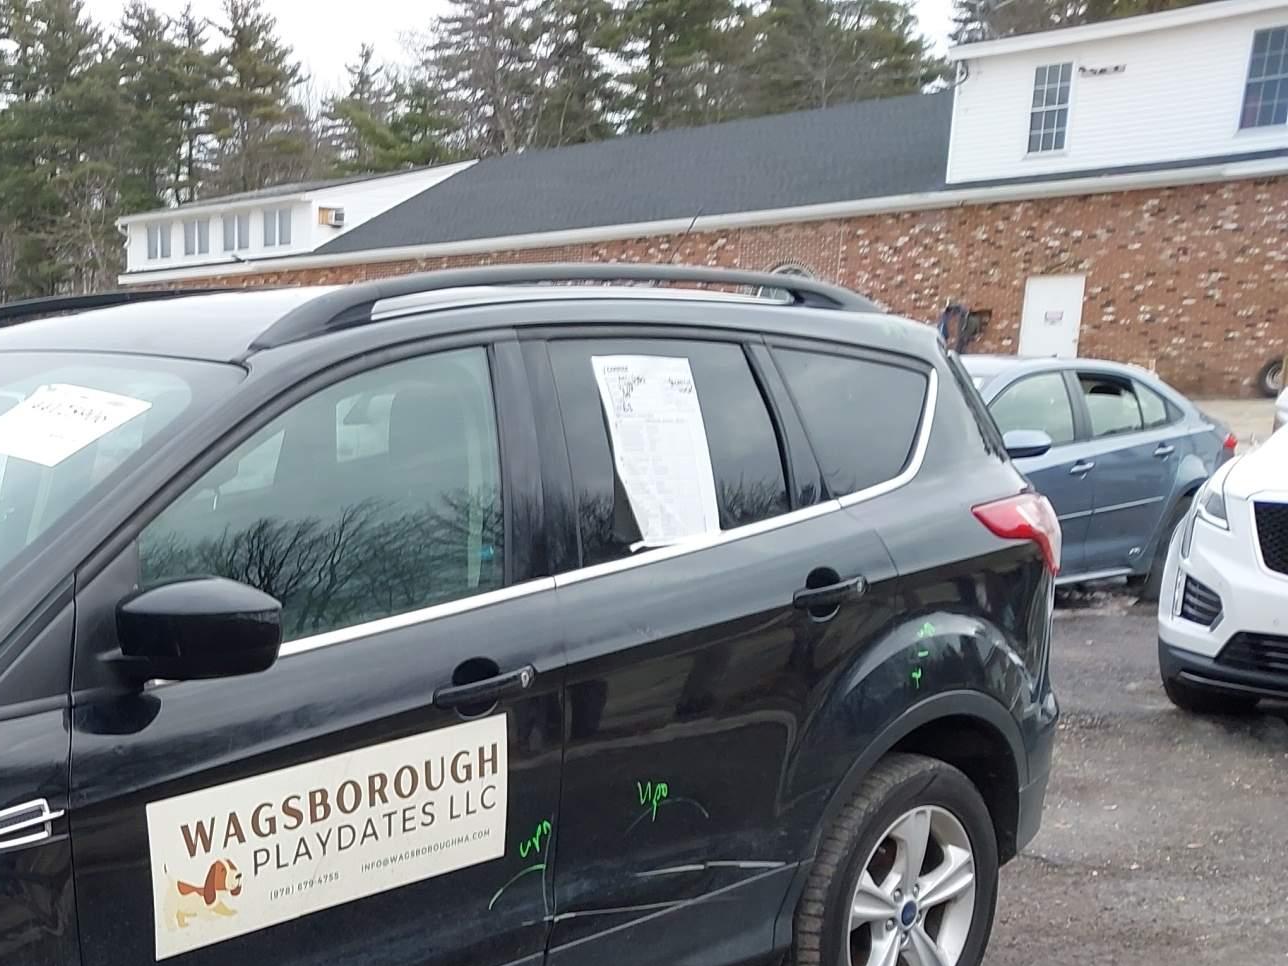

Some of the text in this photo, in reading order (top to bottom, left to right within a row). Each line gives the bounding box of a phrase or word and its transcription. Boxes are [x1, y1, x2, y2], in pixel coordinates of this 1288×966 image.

[180, 743, 497, 859] WAGSBOROUGH
[253, 785, 496, 877] PLAYDATES LLC
